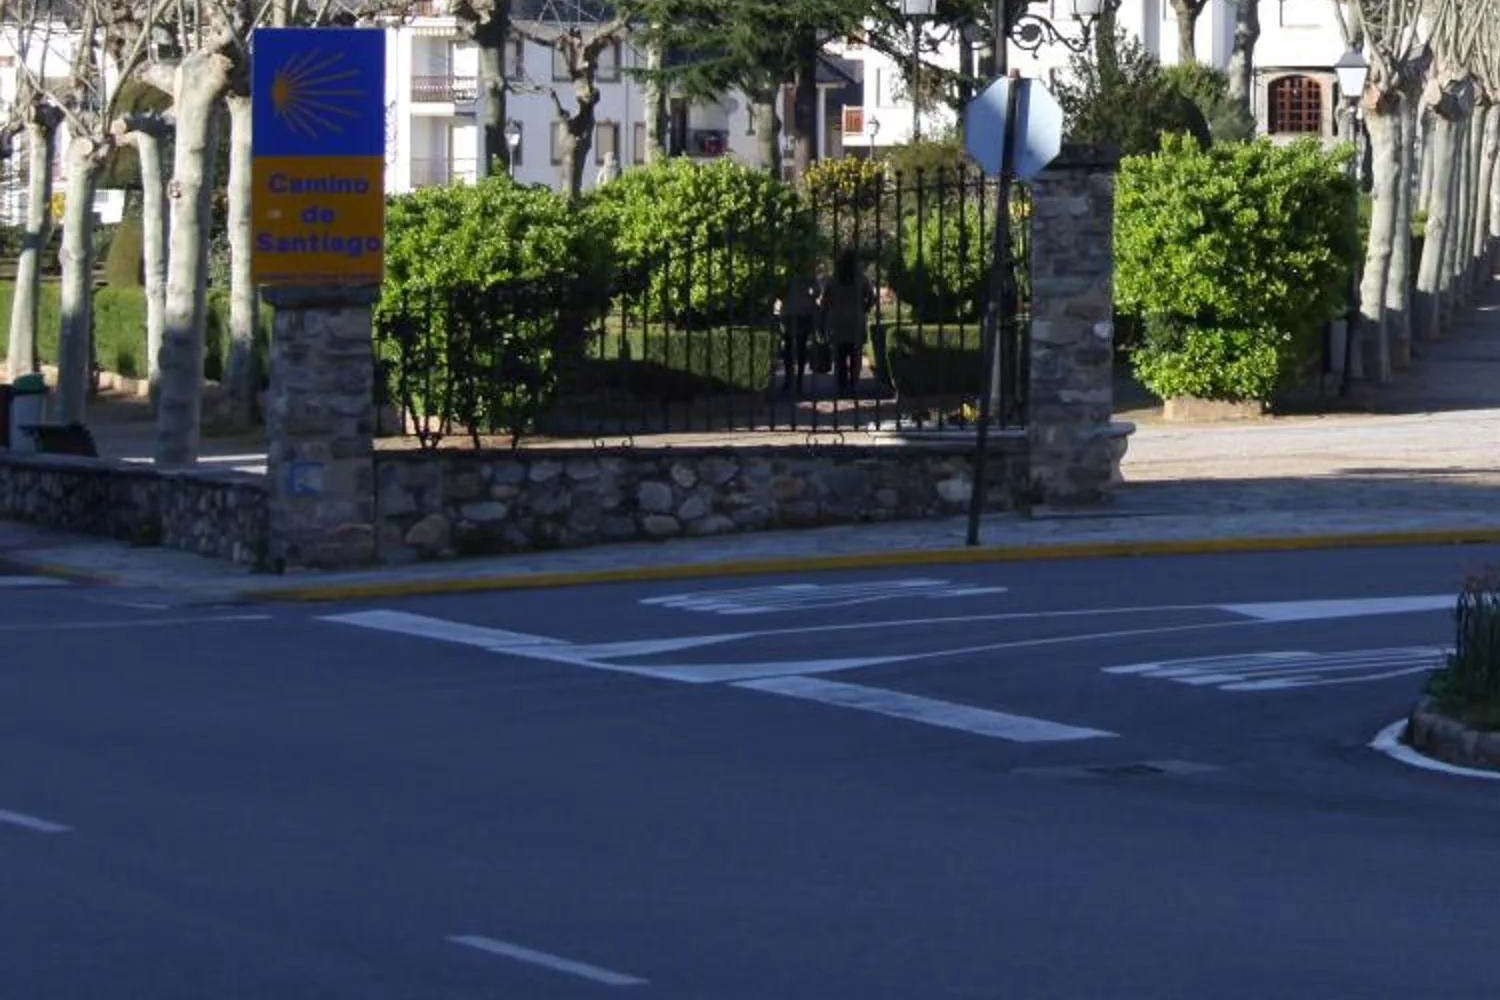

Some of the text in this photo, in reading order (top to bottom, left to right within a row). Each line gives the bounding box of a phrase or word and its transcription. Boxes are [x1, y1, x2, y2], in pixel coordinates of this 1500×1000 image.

[267, 172, 370, 195] Camino
[302, 205, 335, 225] de
[255, 232, 381, 257] Santiago
